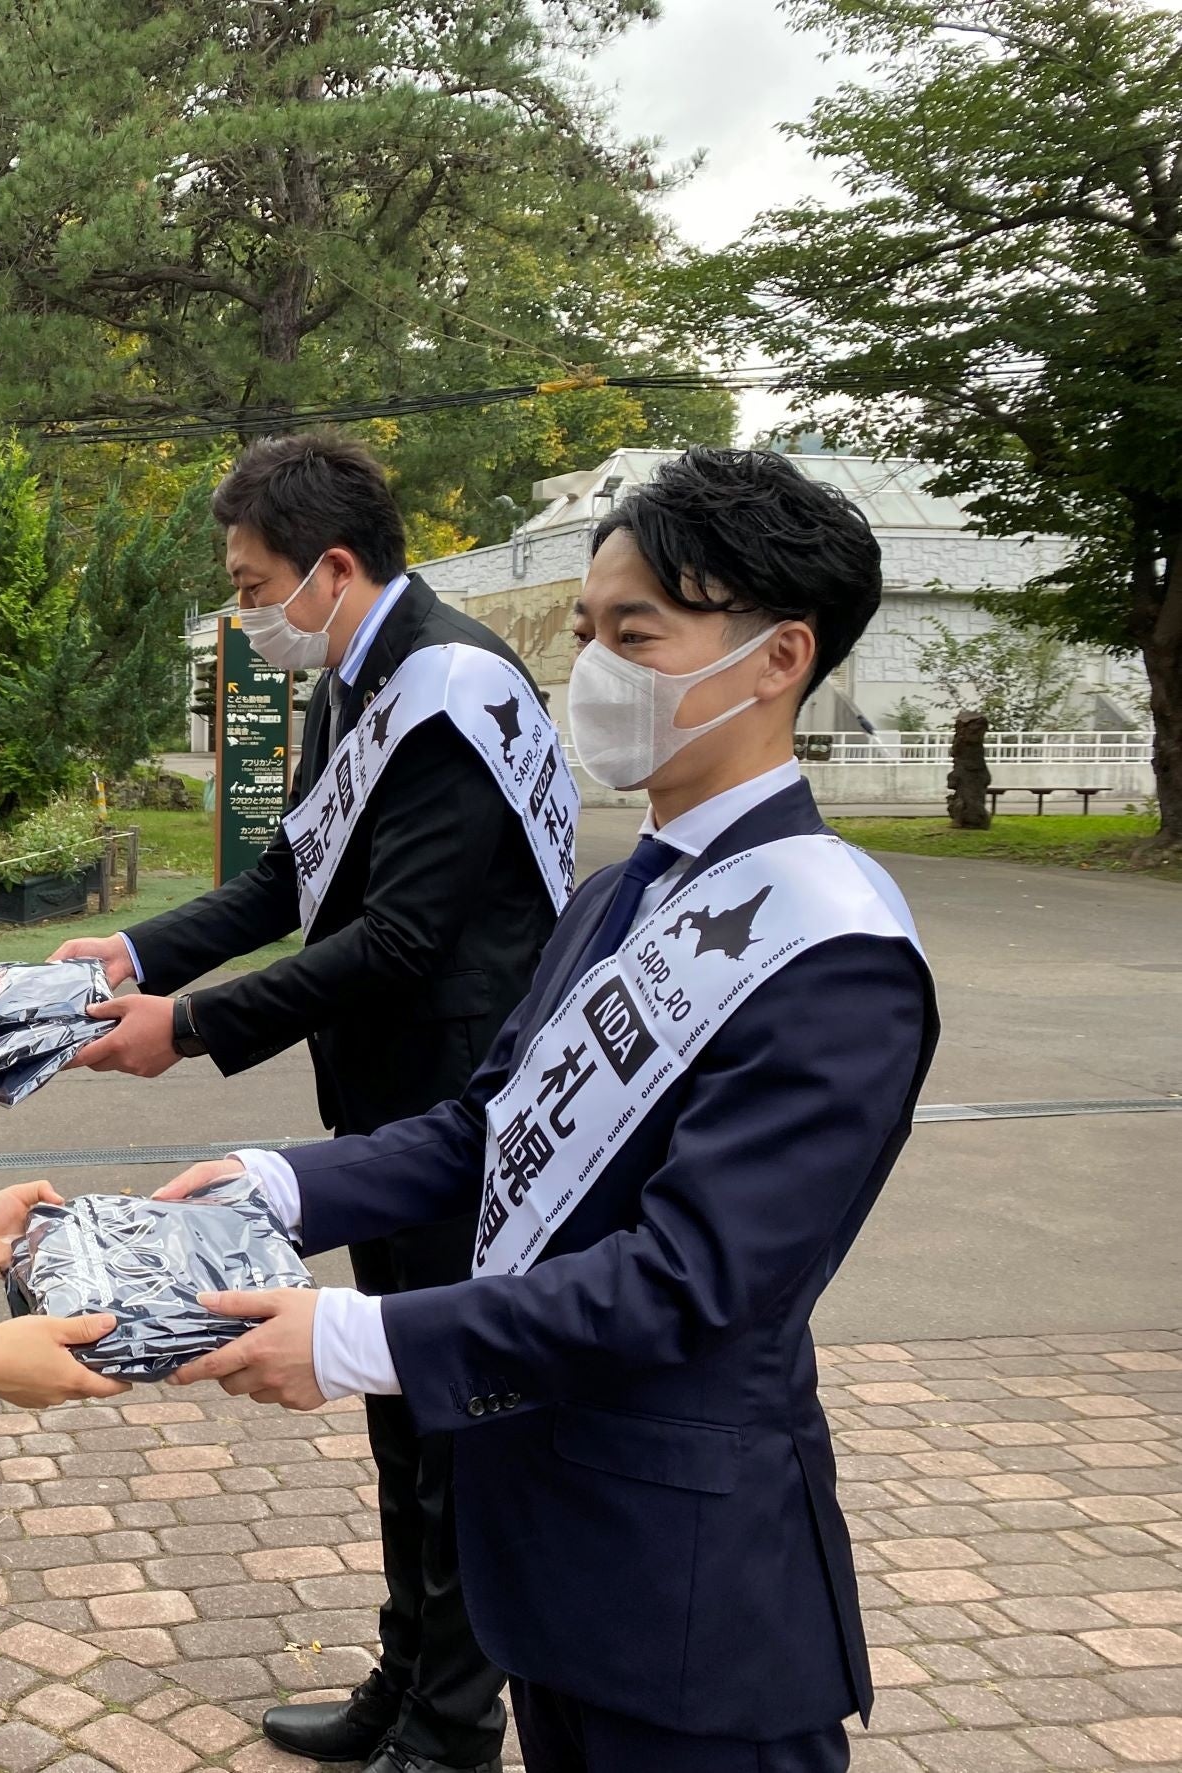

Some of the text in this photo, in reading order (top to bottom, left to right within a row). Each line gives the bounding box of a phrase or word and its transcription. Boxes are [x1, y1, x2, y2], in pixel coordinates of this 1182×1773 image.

[241, 759, 284, 767] アフリカゾーン
[532, 761, 553, 808] NDA
[707, 852, 752, 879] sapporo
[661, 882, 699, 915] sapporo
[621, 919, 655, 953] sapporo
[761, 936, 806, 969] sapporo
[581, 958, 617, 989] sapporo
[718, 972, 755, 1011] sapporo
[550, 993, 578, 1028] sapporo
[593, 990, 639, 1065] NDA
[523, 1035, 544, 1070] sapporo
[678, 1018, 710, 1057] sapporo
[494, 1074, 521, 1107] sapporo
[641, 1060, 673, 1099] sapporo
[607, 1105, 637, 1143] sapporo
[578, 1145, 605, 1183] sapporo
[545, 1188, 574, 1223] sapporo
[520, 1226, 544, 1260] sapporo
